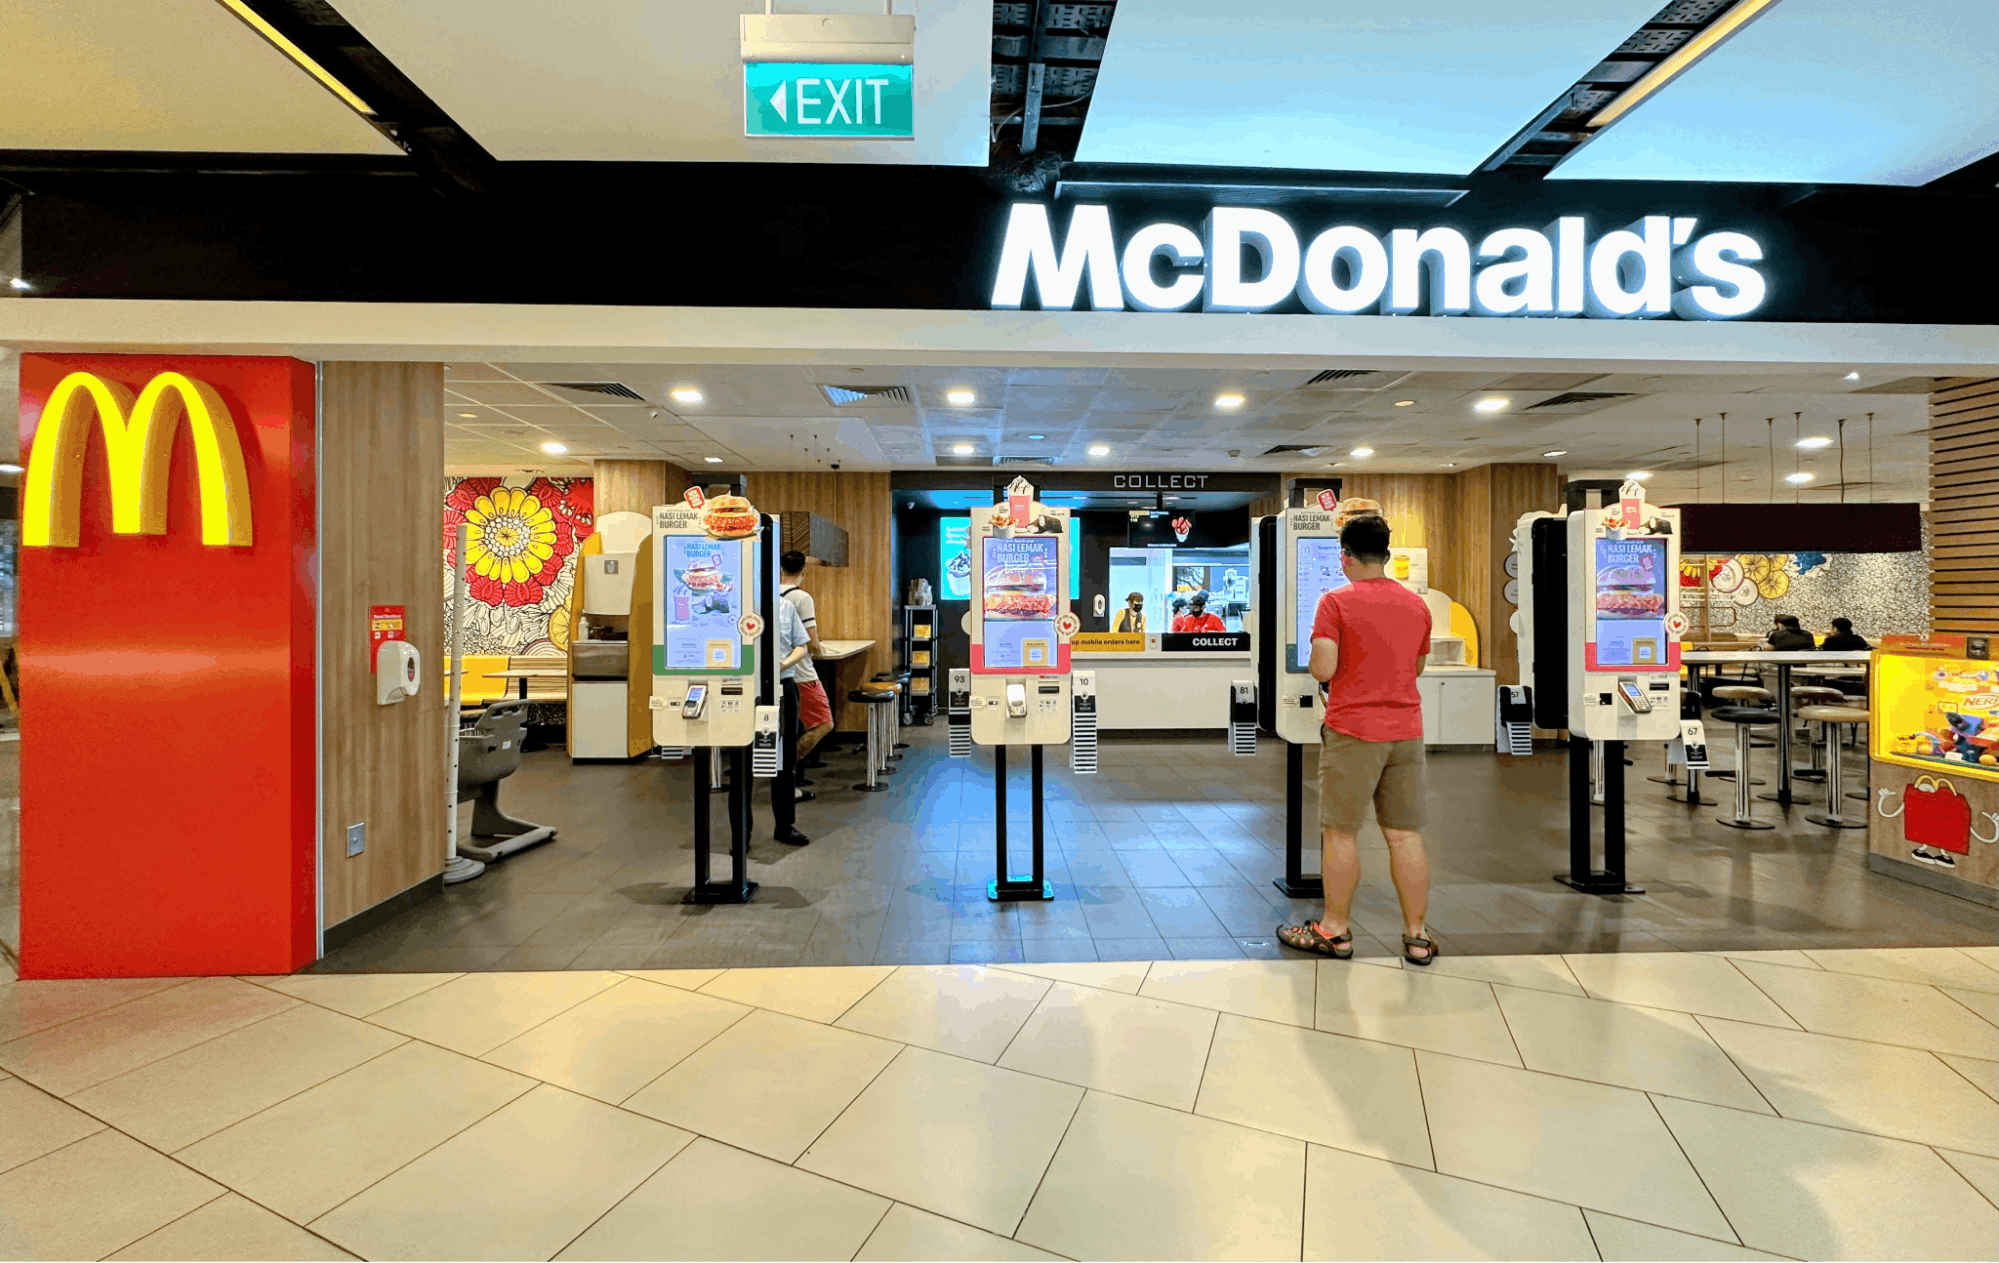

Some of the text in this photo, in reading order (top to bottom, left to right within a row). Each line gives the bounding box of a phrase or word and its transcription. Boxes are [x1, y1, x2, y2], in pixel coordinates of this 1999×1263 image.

[796, 78, 889, 124] EXIT
[990, 202, 1768, 318] McDonald's
[1113, 475, 1209, 488] COLLECT
[659, 512, 698, 520] NASI LEMAK
[1293, 514, 1331, 522] NASI LEMAK
[659, 520, 688, 529] BURGER
[1293, 522, 1320, 531] BURGER
[997, 543, 1044, 553] NASI LEMAK
[1607, 544, 1652, 554] NASI LEMAK
[686, 550, 711, 558] BURGER
[997, 553, 1030, 563] BURGER
[1607, 554, 1640, 564] BURGER
[1192, 637, 1239, 647] COLLECT
[954, 675, 965, 684] 93
[1079, 678, 1089, 686] 10
[1239, 686, 1249, 694] 81
[763, 713, 770, 722] 8
[1688, 727, 1698, 736] 67
